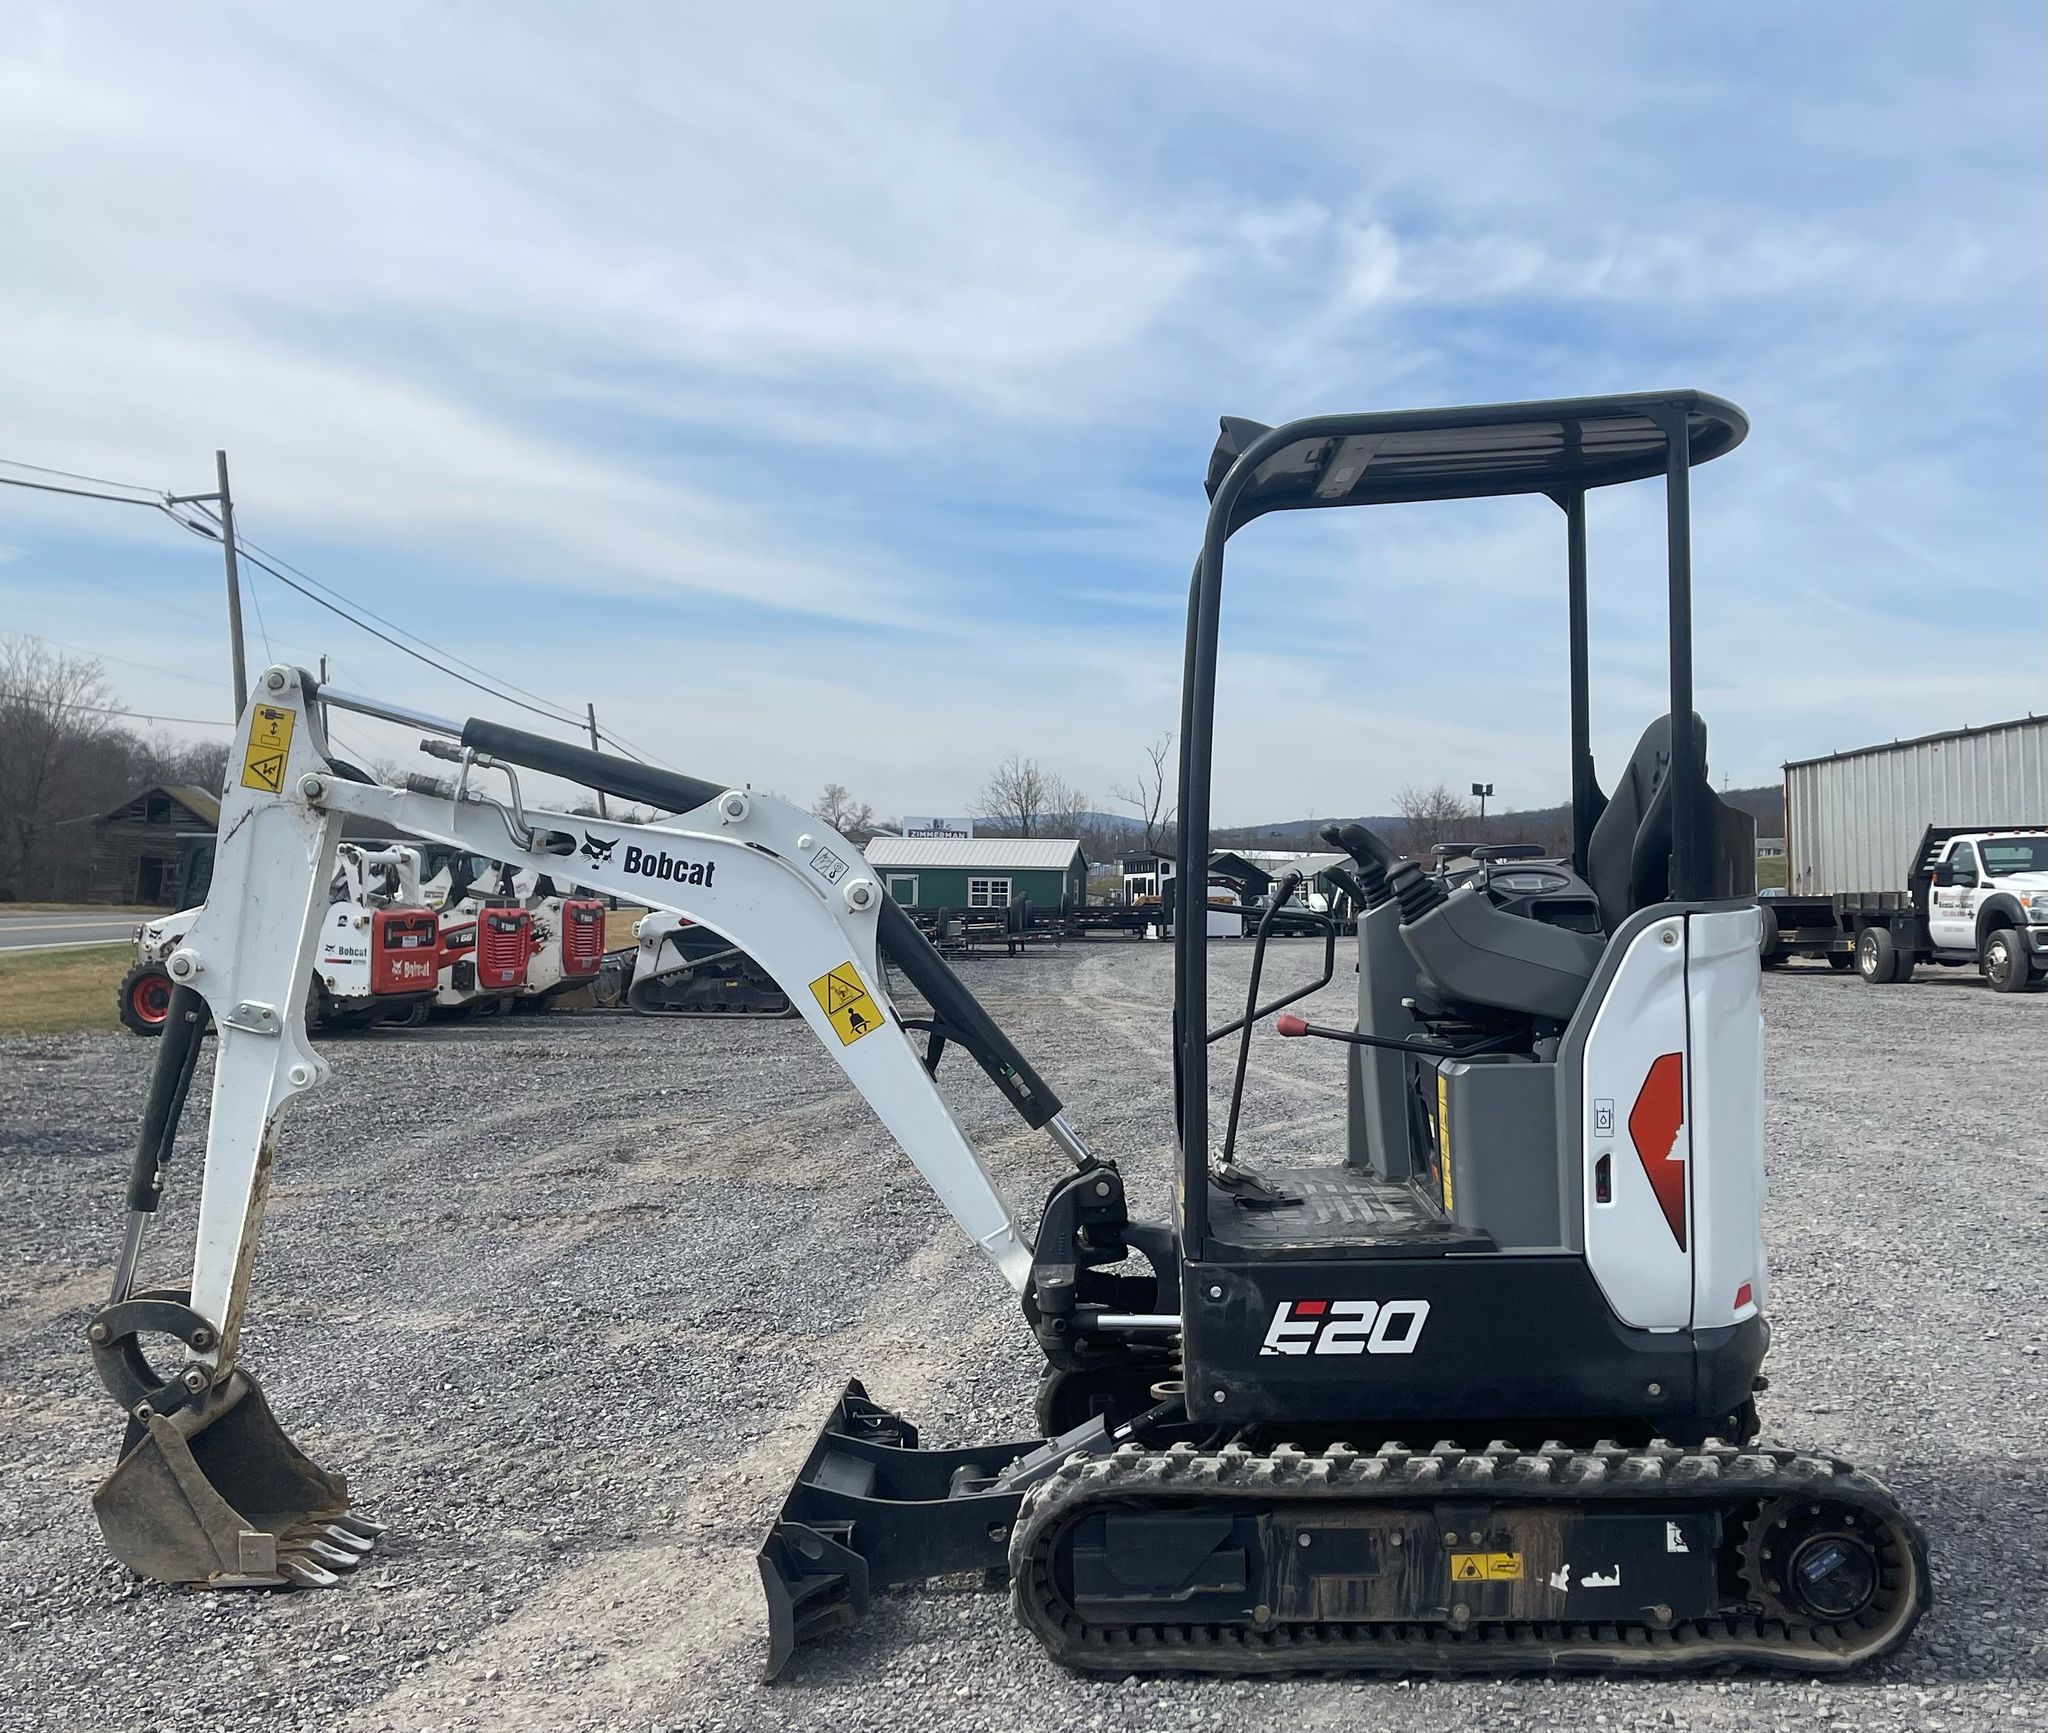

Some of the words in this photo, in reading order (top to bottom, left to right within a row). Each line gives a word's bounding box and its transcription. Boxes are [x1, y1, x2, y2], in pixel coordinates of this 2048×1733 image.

[910, 830, 965, 839] ZIMMERMAN
[623, 845, 715, 888] Bobcat
[338, 946, 367, 958] Bobcat
[404, 960, 430, 979] Bobcat
[1259, 1300, 1431, 1355] E20
